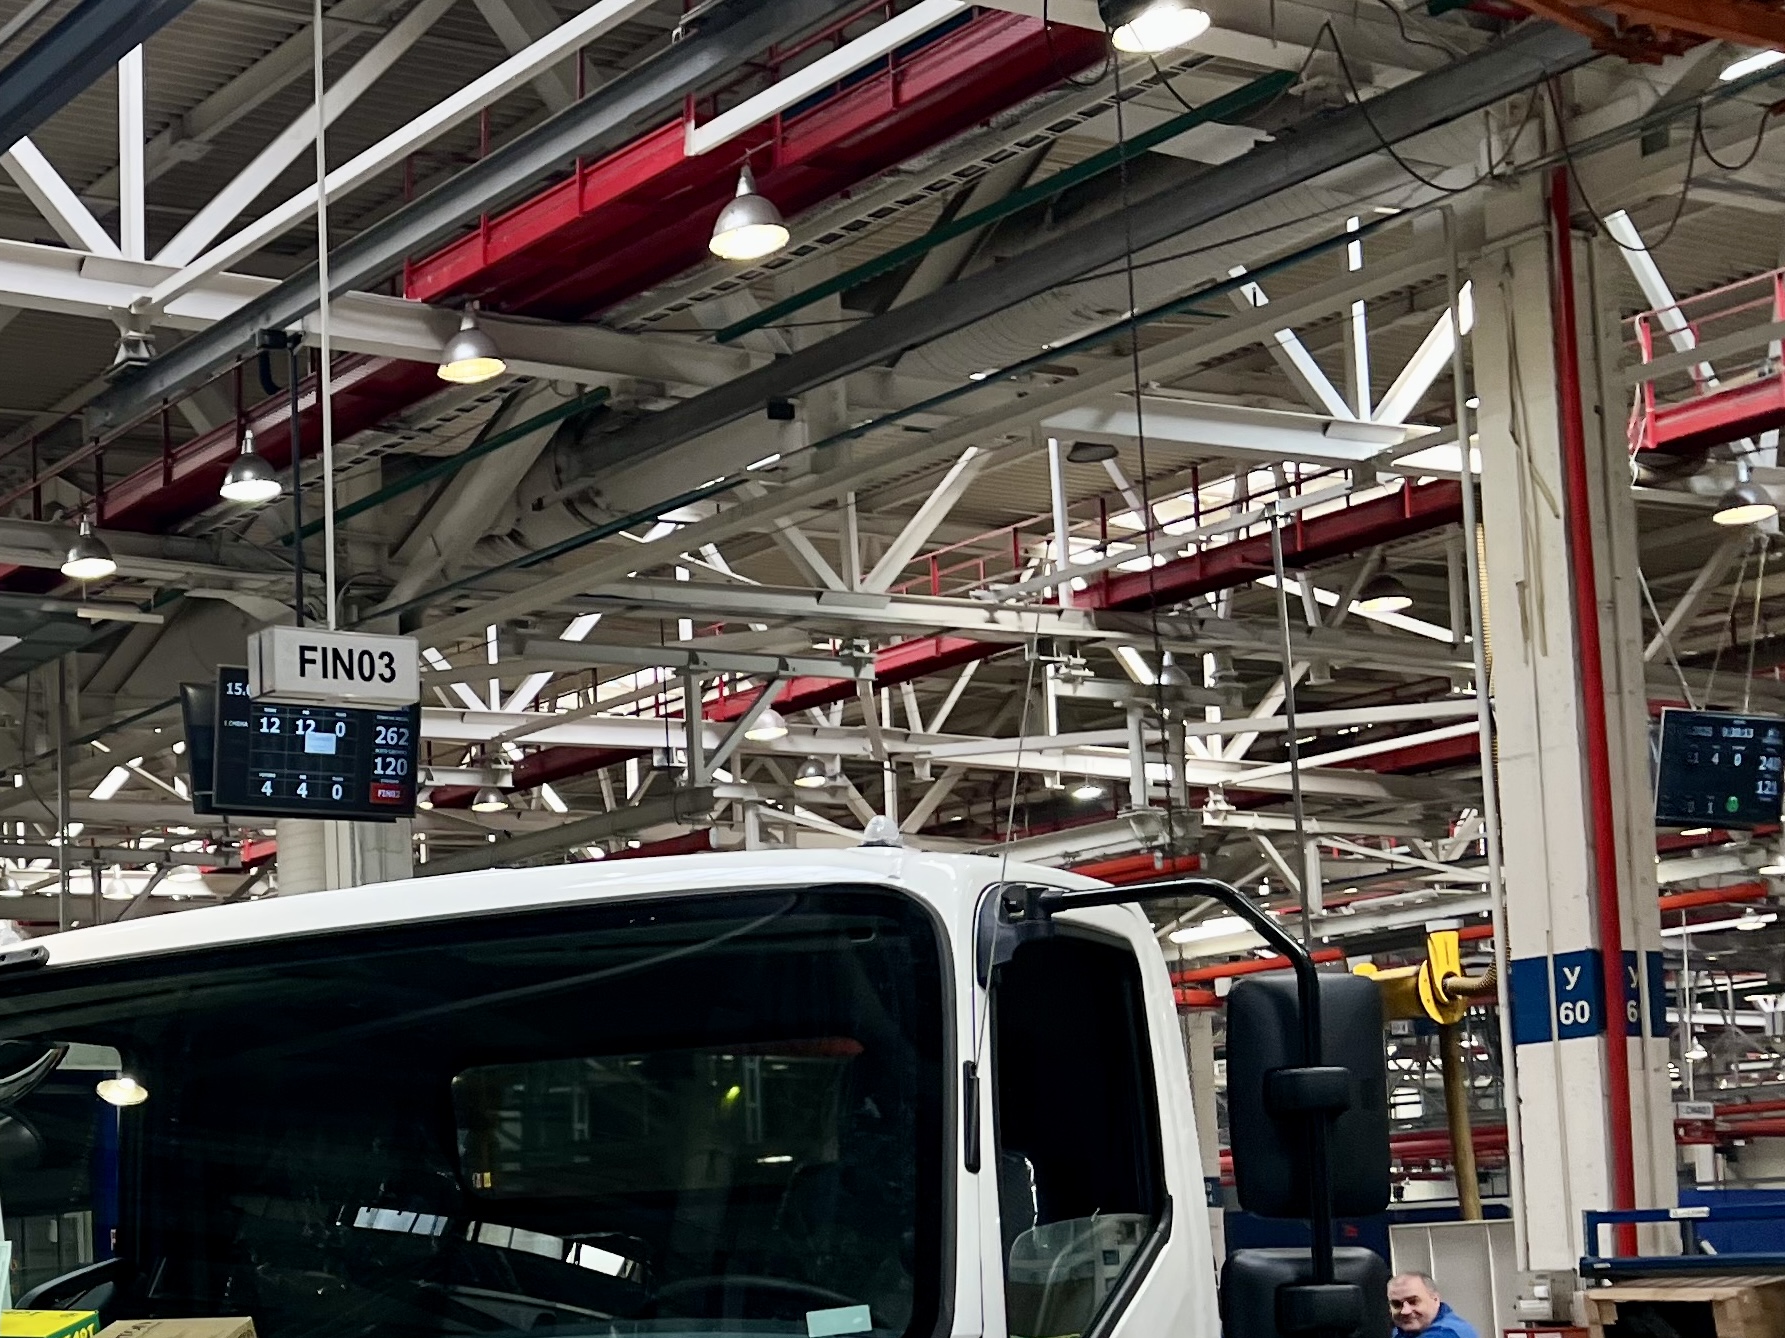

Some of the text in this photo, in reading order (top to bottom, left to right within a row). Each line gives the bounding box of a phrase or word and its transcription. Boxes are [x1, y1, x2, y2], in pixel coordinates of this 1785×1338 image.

[299, 645, 396, 683] FIN03
[259, 717, 280, 733] 12
[295, 719, 316, 735] 12
[335, 721, 346, 738] 0
[375, 726, 409, 746] 262
[374, 757, 408, 776] 120
[261, 781, 273, 797] 4
[297, 782, 308, 799] 4
[332, 784, 343, 800] 0
[1559, 1000, 1591, 1026] 60
